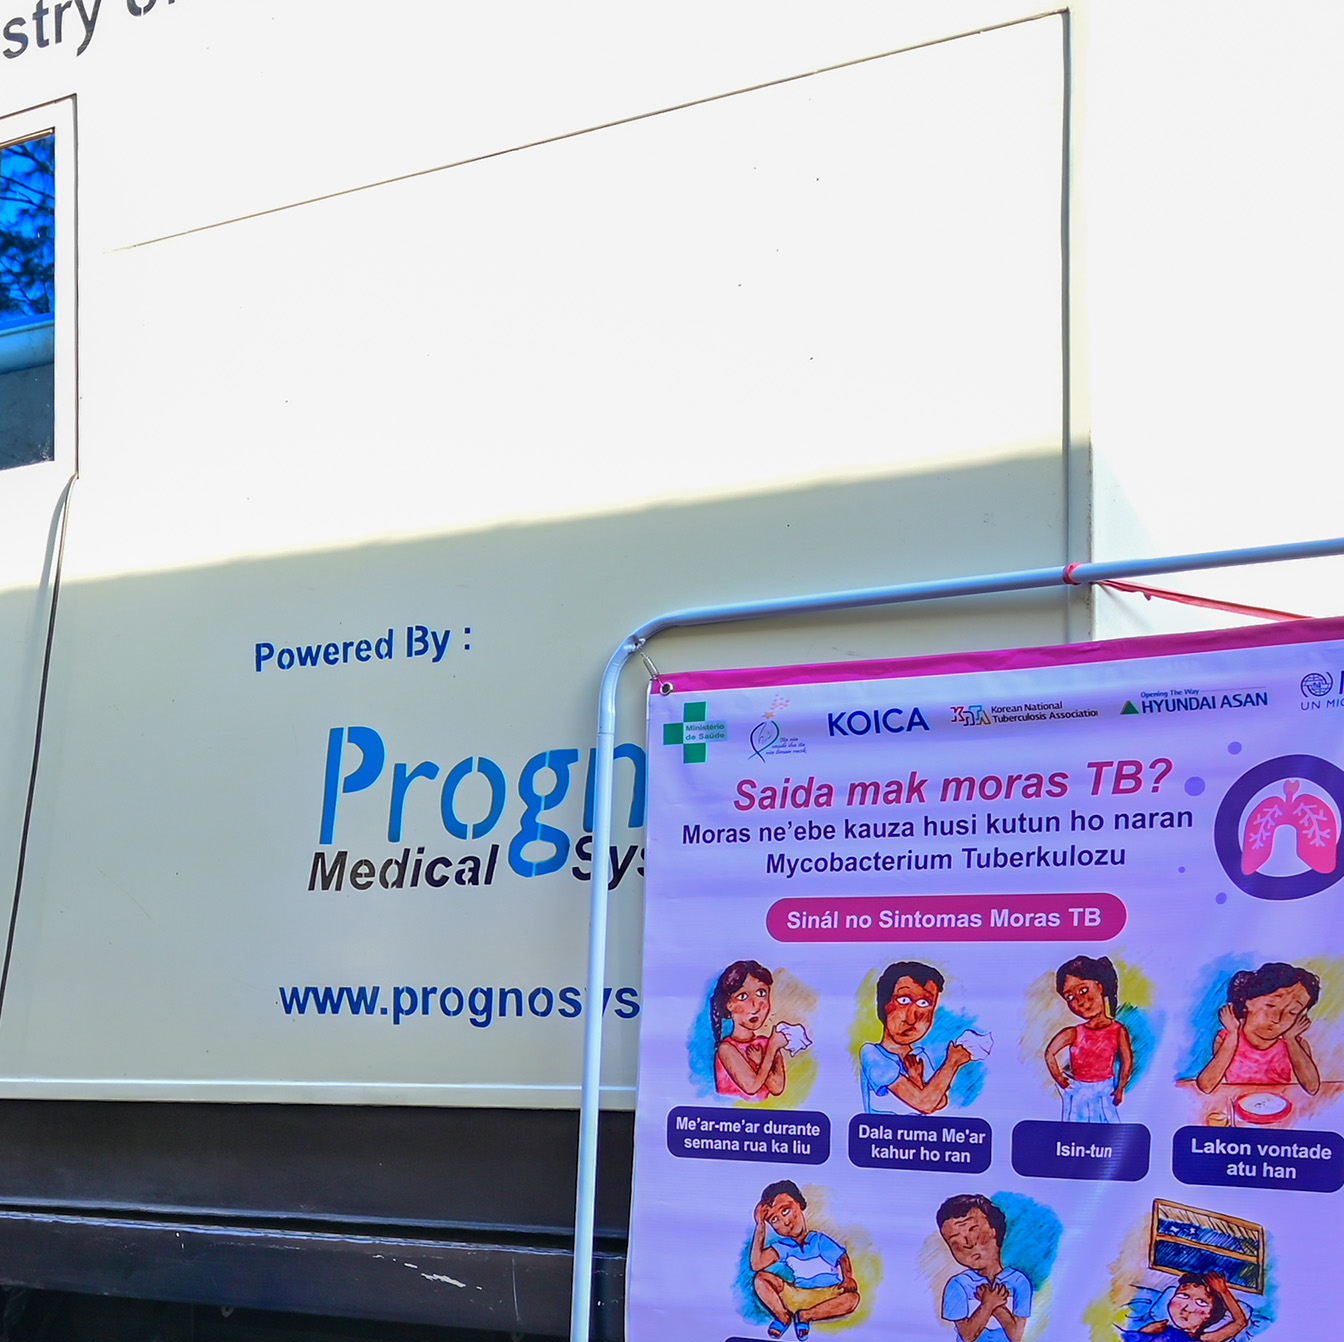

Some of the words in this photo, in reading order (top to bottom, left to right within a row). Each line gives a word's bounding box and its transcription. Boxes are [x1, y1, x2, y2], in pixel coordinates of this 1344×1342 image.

[255, 629, 393, 672] Powered
[406, 626, 450, 662] By
[1141, 690, 1168, 699] Opening
[1142, 696, 1215, 713] HYUNDAI
[1220, 692, 1268, 708] ASAN
[991, 705, 1023, 713] Korean
[1024, 701, 1062, 712] National
[1301, 701, 1320, 710] UN
[828, 707, 929, 736] KOICA
[992, 711, 1046, 723] Tuberculosis
[734, 776, 833, 813] Saida
[846, 771, 928, 807] mak
[940, 770, 1069, 803] moras
[1086, 758, 1172, 796] TB?
[682, 822, 751, 844] Moras
[844, 816, 914, 838] kauza
[923, 813, 977, 837] husi
[986, 812, 1061, 835] kutun
[1071, 809, 1104, 831] ho
[1114, 810, 1193, 830] naran
[308, 844, 500, 891] Medical
[766, 849, 952, 877] Mycobacterium
[962, 845, 1125, 869] Tuberkulozu
[787, 909, 838, 930] Sinál
[845, 914, 872, 929] no
[878, 909, 982, 929] Sintomas
[989, 908, 1060, 928] Moras
[1069, 908, 1101, 927] TB
[764, 1121, 820, 1136] durante
[859, 1125, 893, 1140] Dala
[897, 1129, 936, 1142] ruma
[684, 1138, 739, 1151] semana
[744, 1140, 767, 1152] rua
[771, 1139, 788, 1153] ka
[793, 1141, 810, 1154] liu
[871, 1146, 915, 1161] kahur
[920, 1147, 940, 1162] ho
[945, 1151, 970, 1162] ran
[1056, 1141, 1112, 1158] Isin-tun
[1191, 1138, 1251, 1156] Lakon
[1256, 1141, 1332, 1159] vontade
[1226, 1162, 1256, 1178] atu
[1263, 1163, 1296, 1179] han
